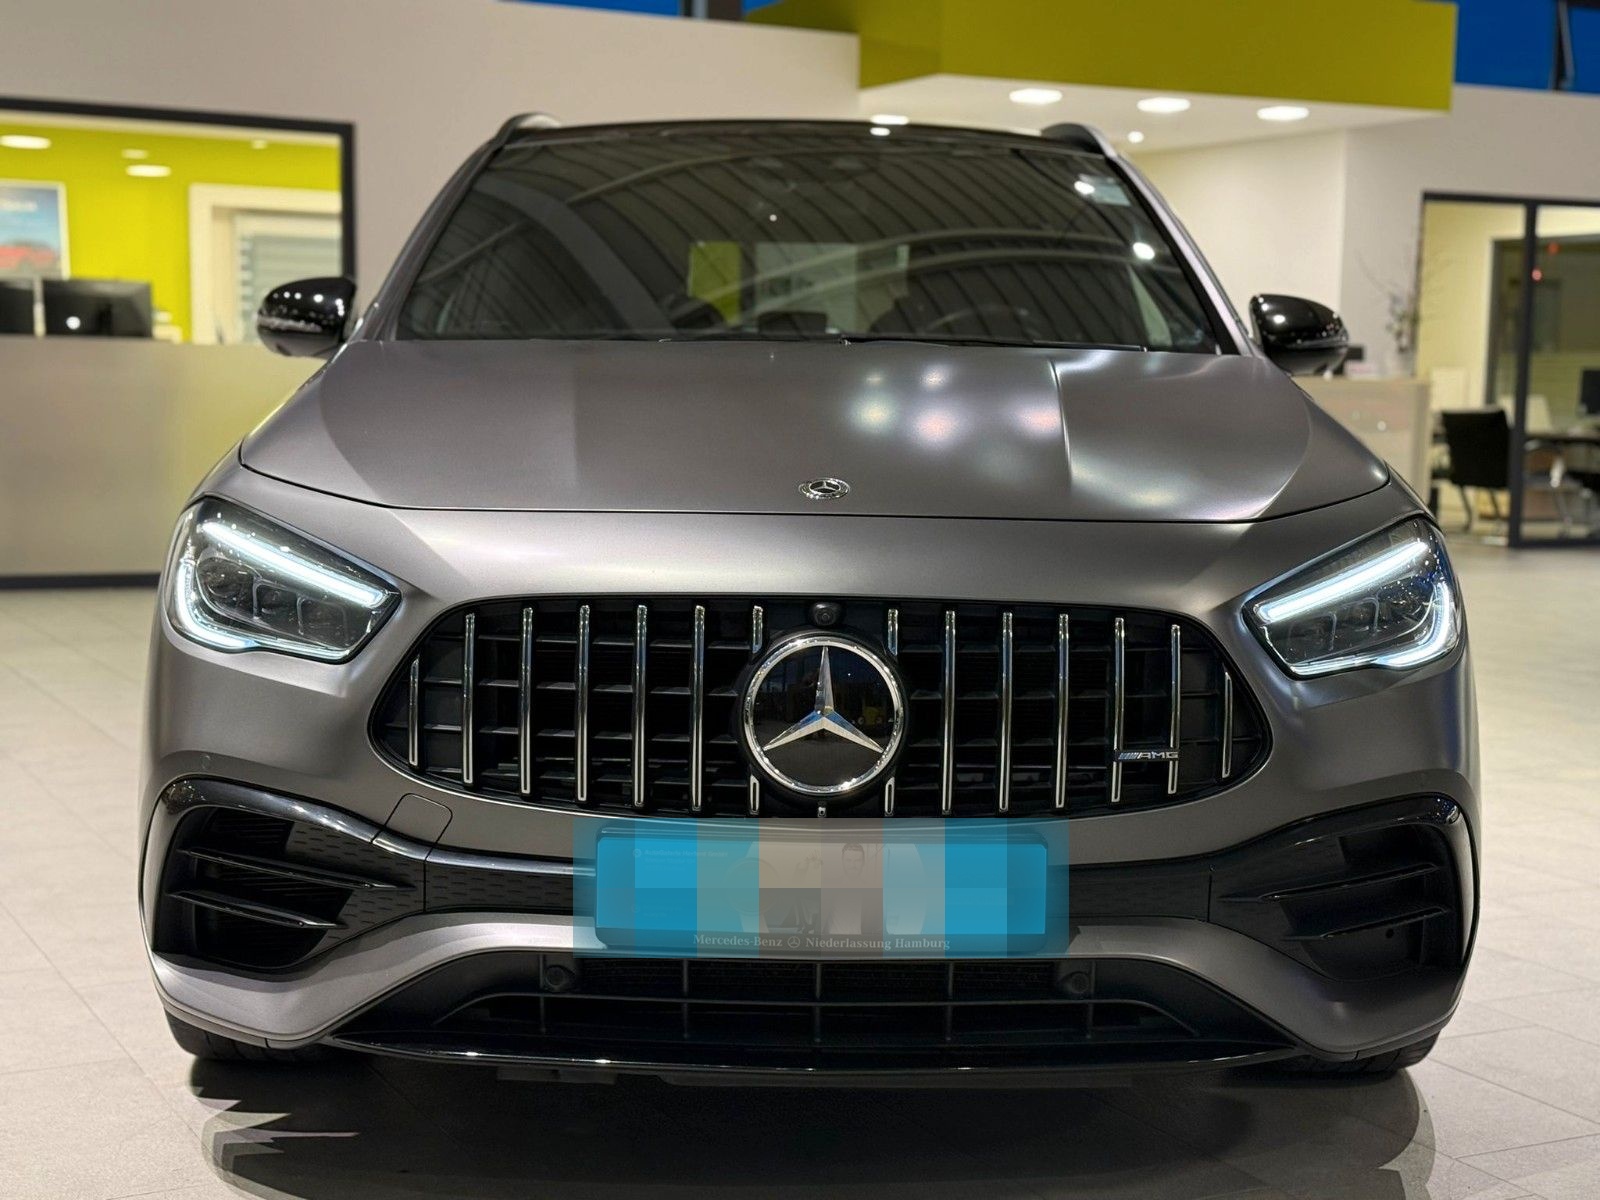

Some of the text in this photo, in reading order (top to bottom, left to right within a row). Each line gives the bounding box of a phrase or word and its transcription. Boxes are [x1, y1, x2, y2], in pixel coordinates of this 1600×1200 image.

[1136, 751, 1179, 760] AMG
[692, 934, 951, 950] Mercedes-Benz Niederlassung Hamburg
